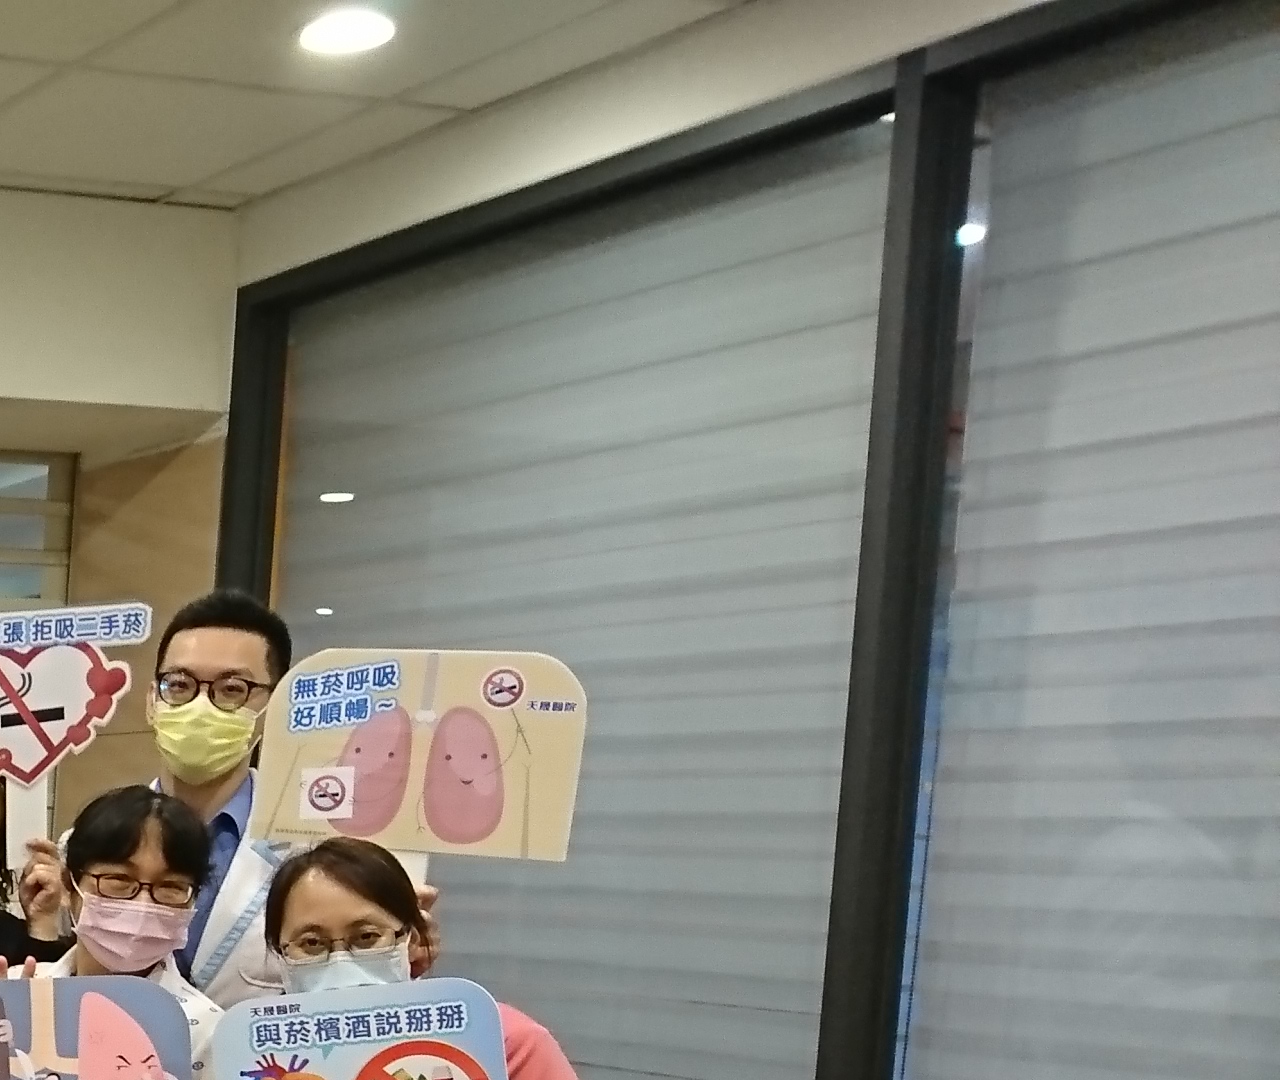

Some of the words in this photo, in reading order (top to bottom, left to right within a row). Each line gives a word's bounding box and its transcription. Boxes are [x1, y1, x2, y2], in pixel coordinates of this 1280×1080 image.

[31, 612, 143, 642] 拒吸二手菸
[294, 664, 399, 700] 無菸呼吸
[250, 1003, 302, 1017] 天晟醫院
